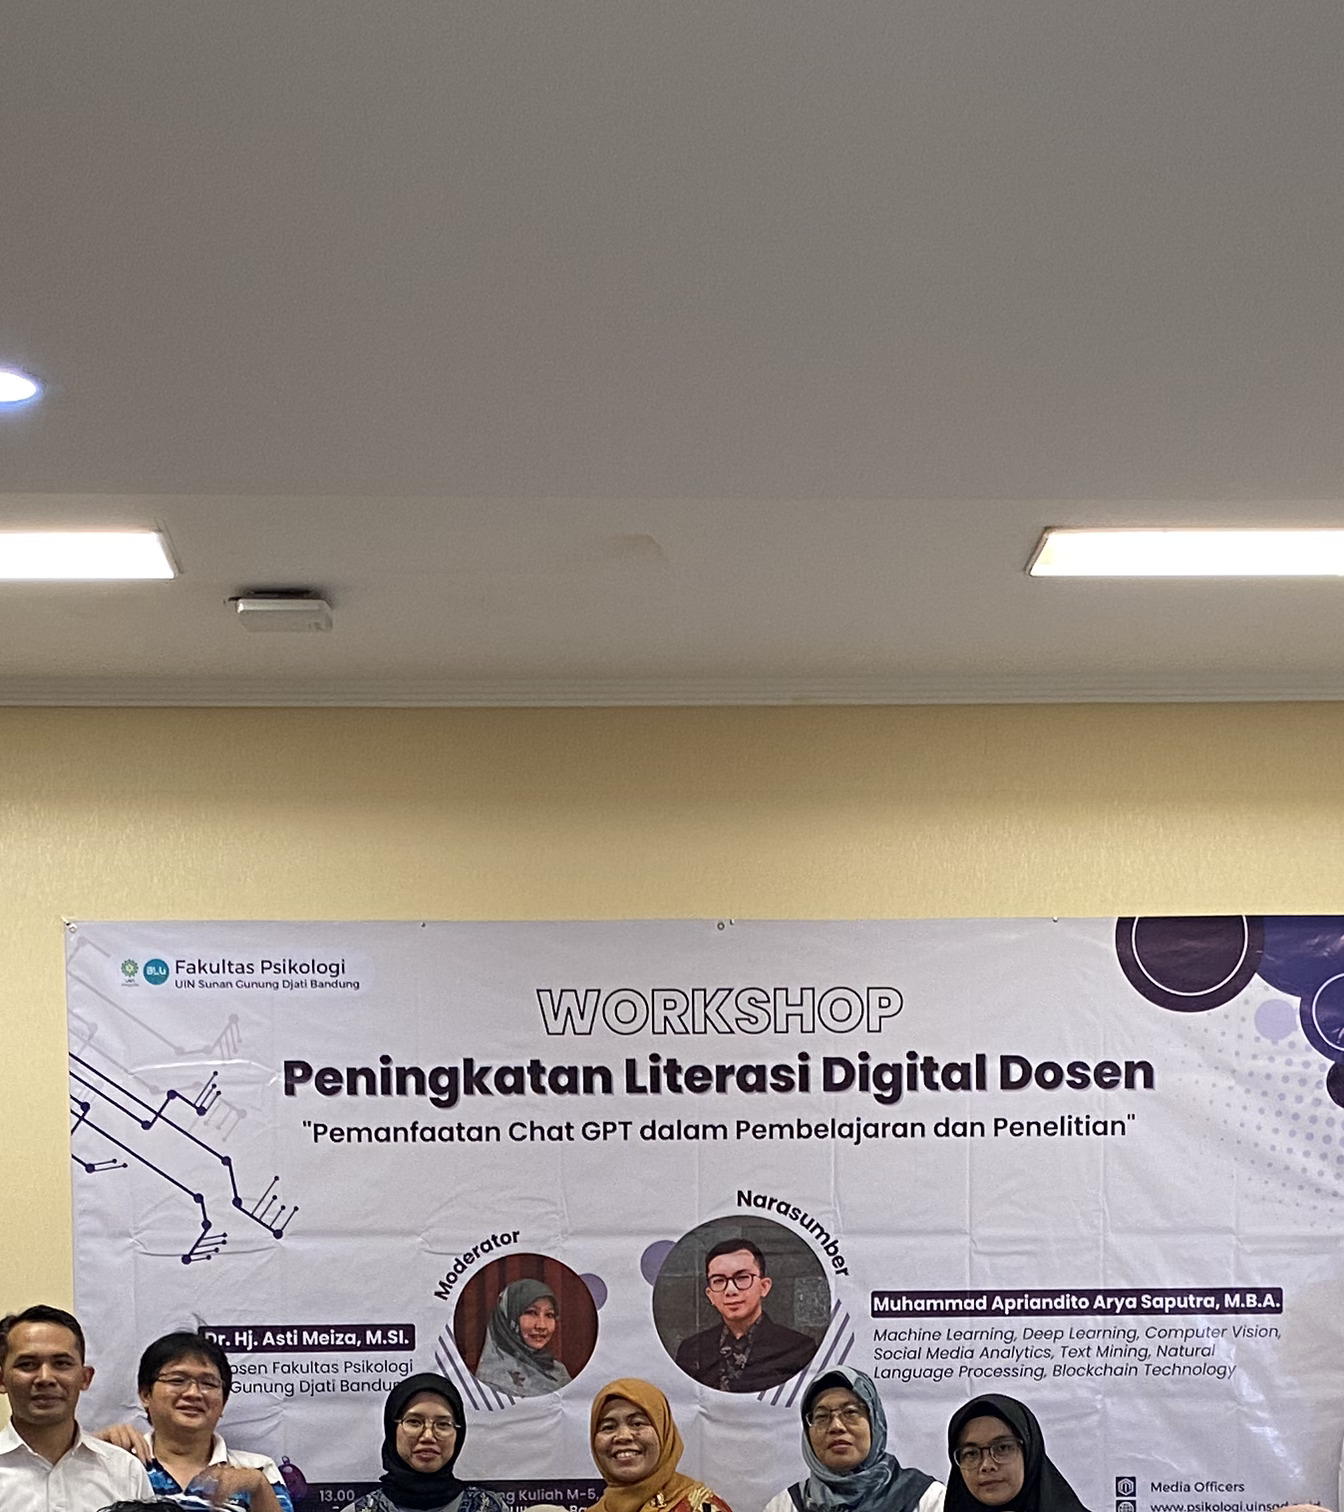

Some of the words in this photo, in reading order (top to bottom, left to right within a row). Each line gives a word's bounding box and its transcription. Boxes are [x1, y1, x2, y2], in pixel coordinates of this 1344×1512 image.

[175, 959, 254, 974] Fakultas
[261, 959, 345, 977] Psikologi
[175, 980, 196, 989] UIN
[198, 980, 233, 989] Sunan
[236, 980, 279, 990] Gunung
[282, 979, 307, 990] Djati
[311, 979, 360, 990] Bandung
[537, 986, 903, 1035] WORKSHOP
[282, 1055, 613, 1109] Peningkatan
[624, 1052, 810, 1096] Literasi
[822, 1051, 987, 1105] Digital
[999, 1054, 1155, 1092] Dosen
[303, 1119, 501, 1143] "Pemanfaatan
[508, 1120, 574, 1142] Chat
[581, 1121, 633, 1141] GPT
[639, 1119, 728, 1141] dalam
[735, 1116, 926, 1145] Pembelajaran
[933, 1116, 986, 1138] dan
[993, 1113, 1136, 1137] Penelitian"
[736, 1189, 850, 1279] Narasumber
[433, 1229, 521, 1301] Moderator
[873, 1295, 988, 1313] Muhammad
[991, 1294, 1091, 1315] Apriandito
[1093, 1295, 1138, 1314] Arya
[1140, 1293, 1220, 1313] Saputra,
[1224, 1293, 1282, 1309] M.B.A.
[234, 1330, 259, 1350] Hj.
[262, 1330, 299, 1346] Asti
[303, 1329, 362, 1348] Meiza,
[365, 1329, 410, 1345] M.SI.
[873, 1328, 942, 1342] Machine
[946, 1327, 1018, 1344] Learning,
[1022, 1327, 1064, 1343] Deep
[1069, 1326, 1140, 1343] Learning,
[1145, 1326, 1227, 1342] Computer
[1231, 1325, 1282, 1339] Vision,
[873, 1346, 921, 1360] Social
[925, 1346, 975, 1360] Media
[979, 1345, 1055, 1362] Analytics,
[1060, 1345, 1093, 1359] Text
[1096, 1344, 1151, 1361] Mining,
[1156, 1344, 1216, 1358] Natural
[230, 1363, 268, 1376] osen
[272, 1360, 339, 1375] Fakultas
[343, 1359, 414, 1379] Psikologi
[873, 1366, 954, 1383] Language
[958, 1364, 1047, 1382] Processing,
[1052, 1363, 1139, 1378] Blockchain
[1143, 1362, 1237, 1380] Technology
[230, 1380, 294, 1396] Gunung
[299, 1380, 336, 1397] Djati
[319, 1489, 355, 1502] 13.00
[519, 1488, 563, 1501] Kuliah
[567, 1488, 600, 1501] M-5,
[1150, 1481, 1190, 1493] Media
[1193, 1481, 1245, 1493] Officers
